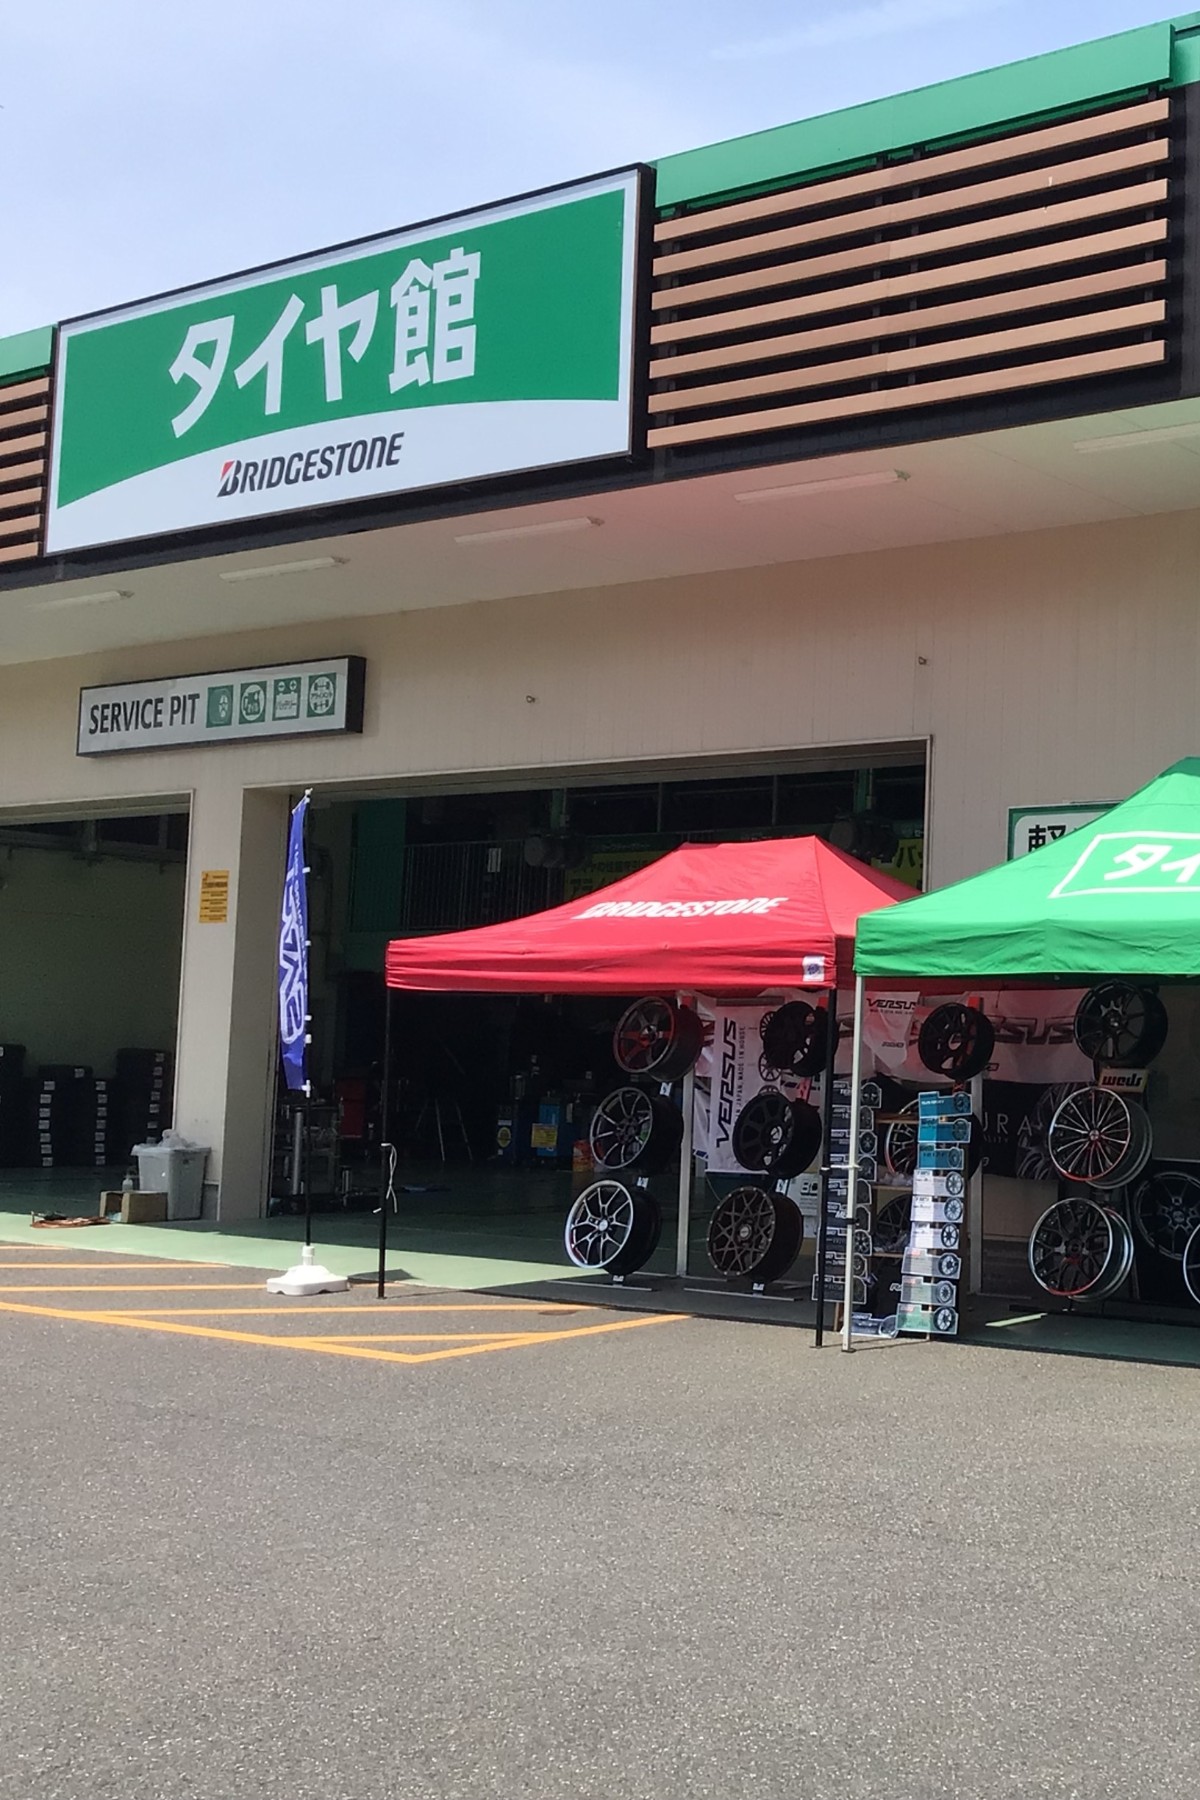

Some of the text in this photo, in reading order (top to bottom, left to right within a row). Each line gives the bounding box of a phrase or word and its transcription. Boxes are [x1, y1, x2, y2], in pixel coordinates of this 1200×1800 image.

[168, 246, 481, 438] タイヤ館
[217, 431, 405, 498] BRIDGESTONE
[88, 693, 200, 735] SERVICE PIT
[572, 896, 790, 920] BRIDGESTONE
[716, 1017, 737, 1148] VERSUS
[1101, 1073, 1143, 1087] weds
